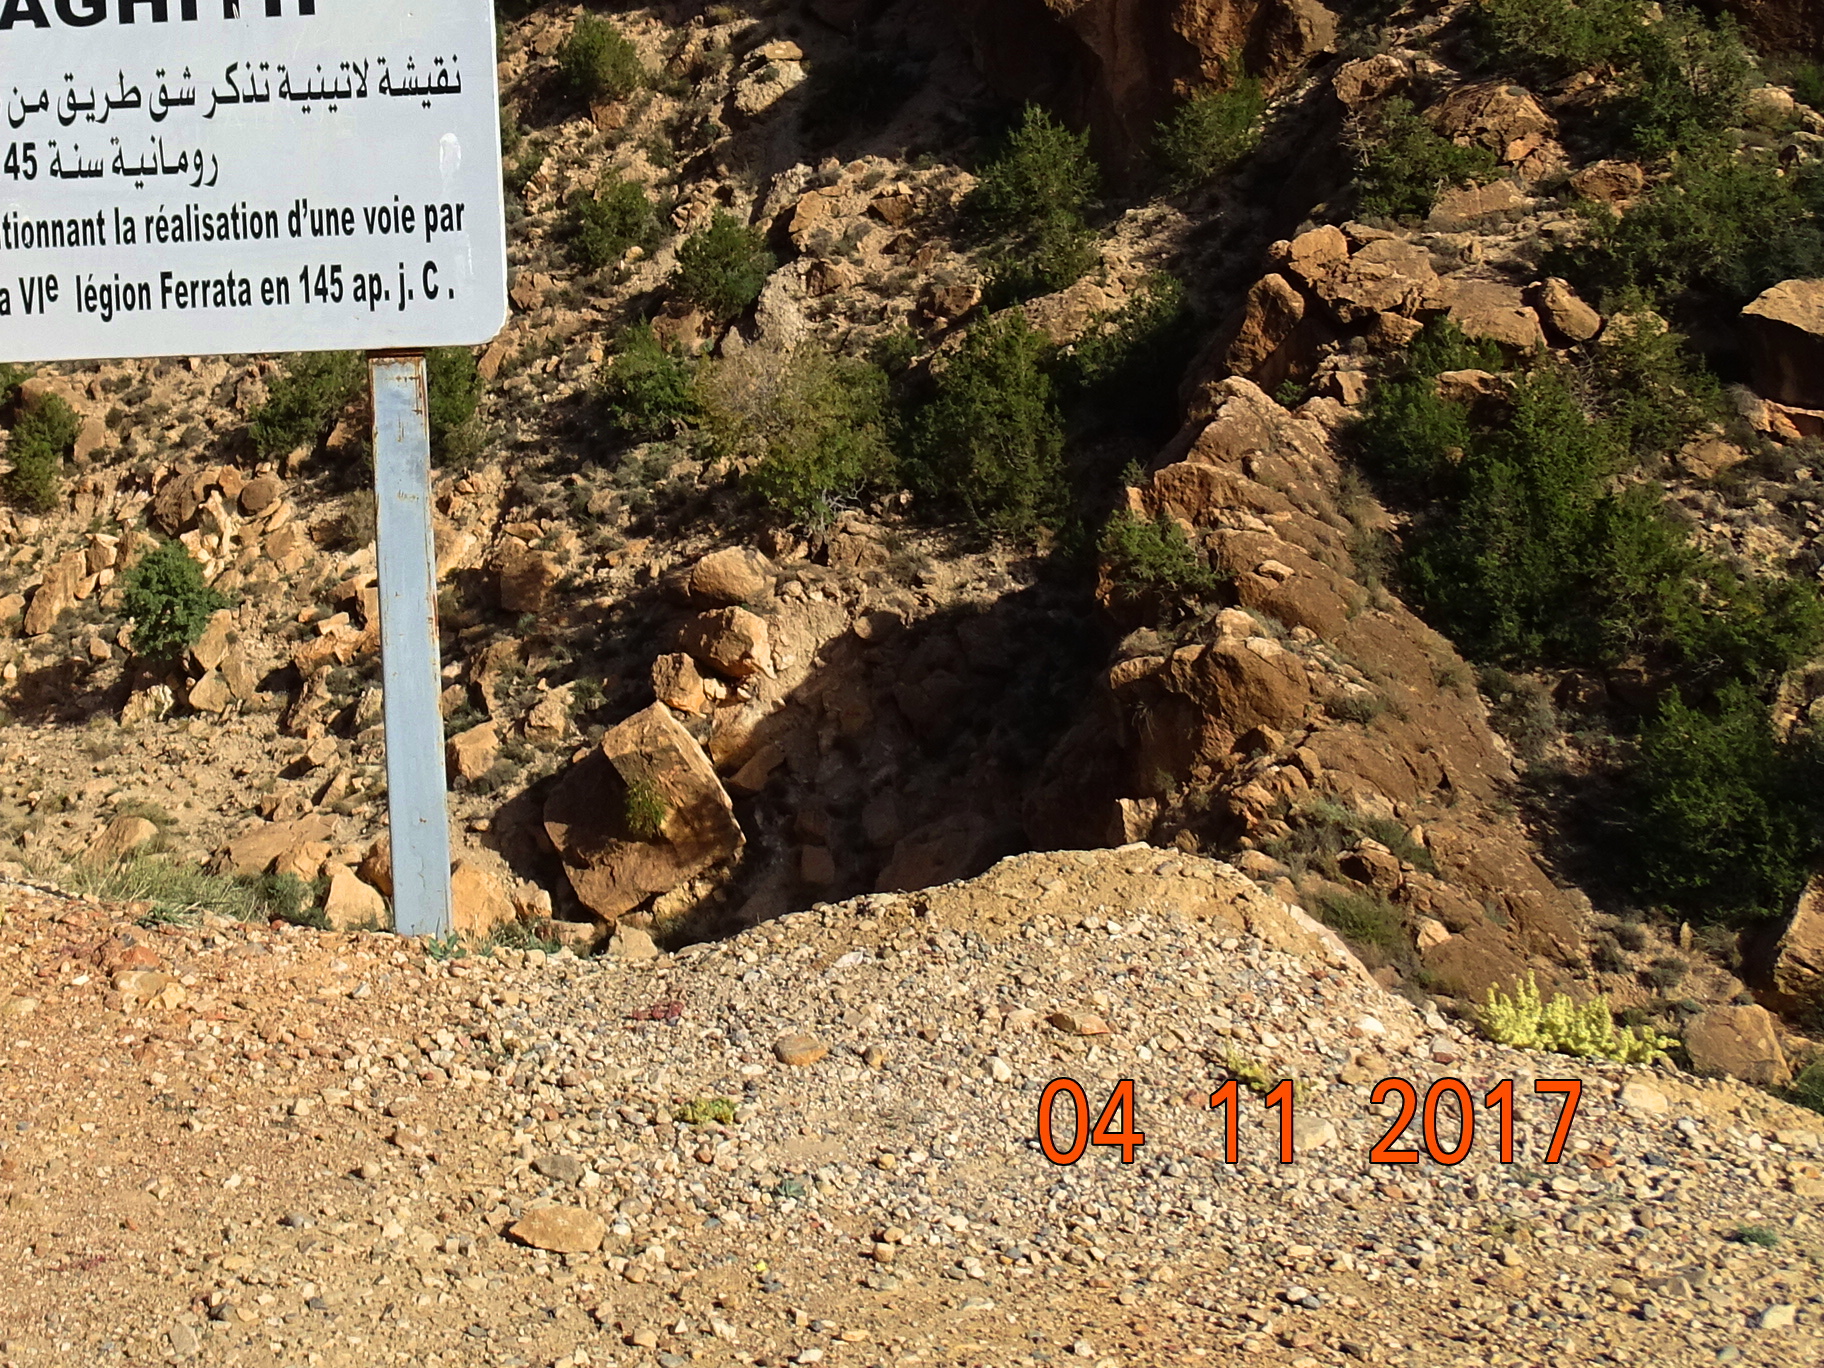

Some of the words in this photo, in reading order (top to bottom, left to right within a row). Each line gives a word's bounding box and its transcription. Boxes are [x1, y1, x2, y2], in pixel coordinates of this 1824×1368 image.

[8, 86, 50, 129] من
[58, 69, 142, 127] طريق
[149, 66, 196, 123] شق
[202, 61, 270, 119] تذكر
[276, 57, 369, 114] لاتينية
[377, 55, 461, 109] نقيشة
[48, 139, 104, 180] سنة
[111, 135, 219, 190] رومانية
[115, 206, 137, 245] la
[146, 201, 279, 245] réalisation
[287, 198, 355, 239] d’une
[362, 194, 416, 236] voie
[425, 202, 466, 243] par
[76, 273, 152, 323] légion
[160, 268, 252, 310] Ferrata
[261, 276, 290, 306] en
[300, 264, 344, 304] 145
[352, 272, 390, 312] ap.
[398, 261, 414, 312] j.
